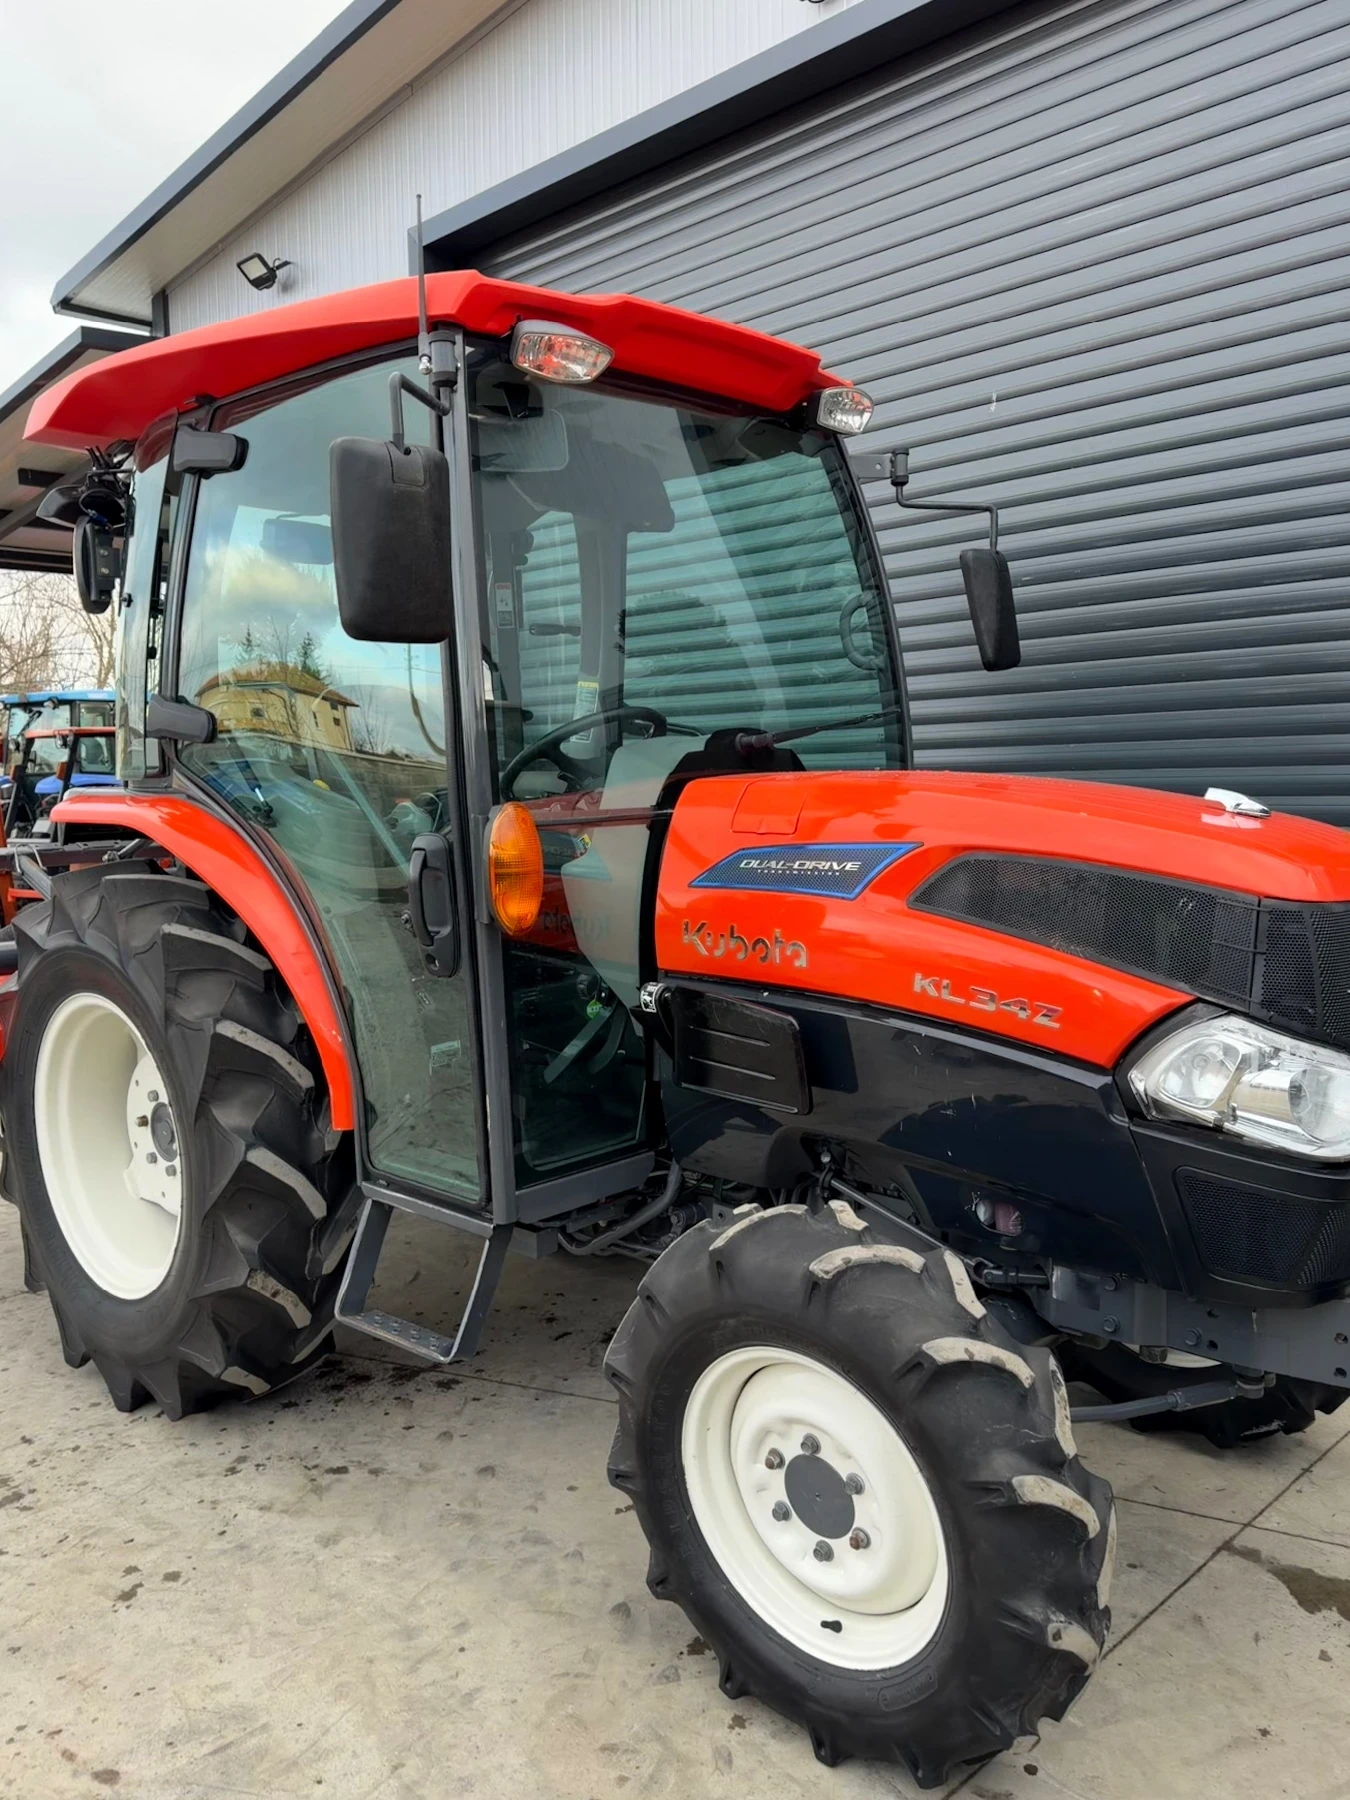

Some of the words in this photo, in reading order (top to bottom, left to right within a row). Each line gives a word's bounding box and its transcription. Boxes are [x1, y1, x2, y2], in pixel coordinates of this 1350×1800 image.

[739, 859, 862, 871] DUAL-DRIVE
[682, 919, 809, 968] Kubota
[913, 972, 1064, 1029] KL34Z
